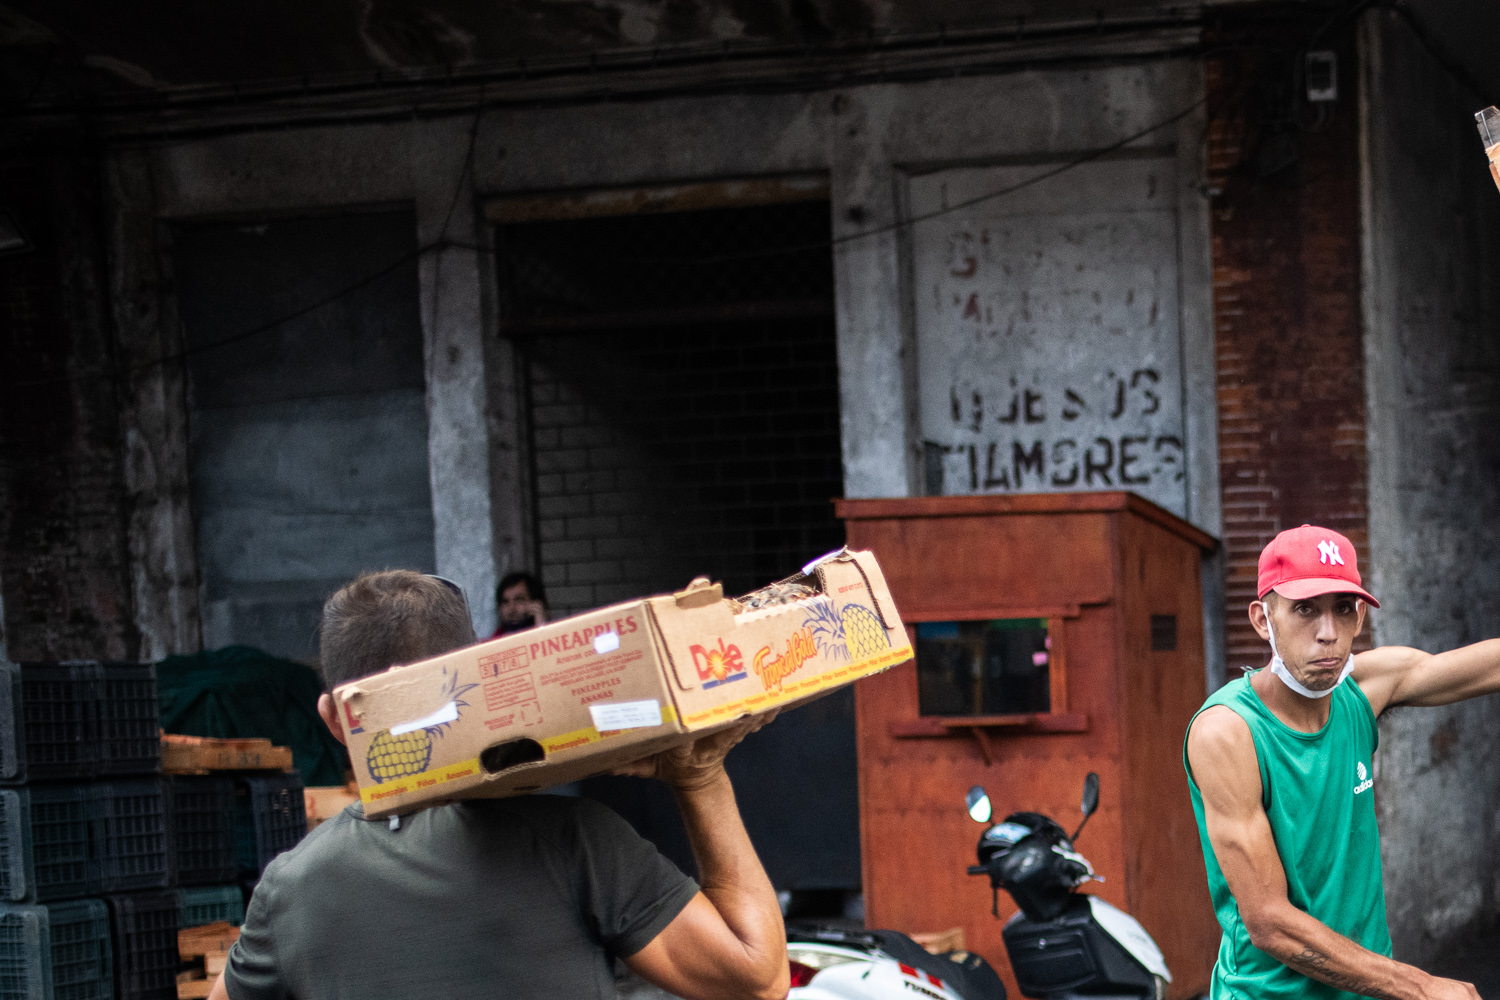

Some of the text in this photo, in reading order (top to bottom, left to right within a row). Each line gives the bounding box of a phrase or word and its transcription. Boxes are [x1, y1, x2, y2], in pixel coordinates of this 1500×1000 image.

[689, 637, 744, 681] Dole
[790, 626, 818, 669] Gold
[1353, 778, 1373, 795] adida
